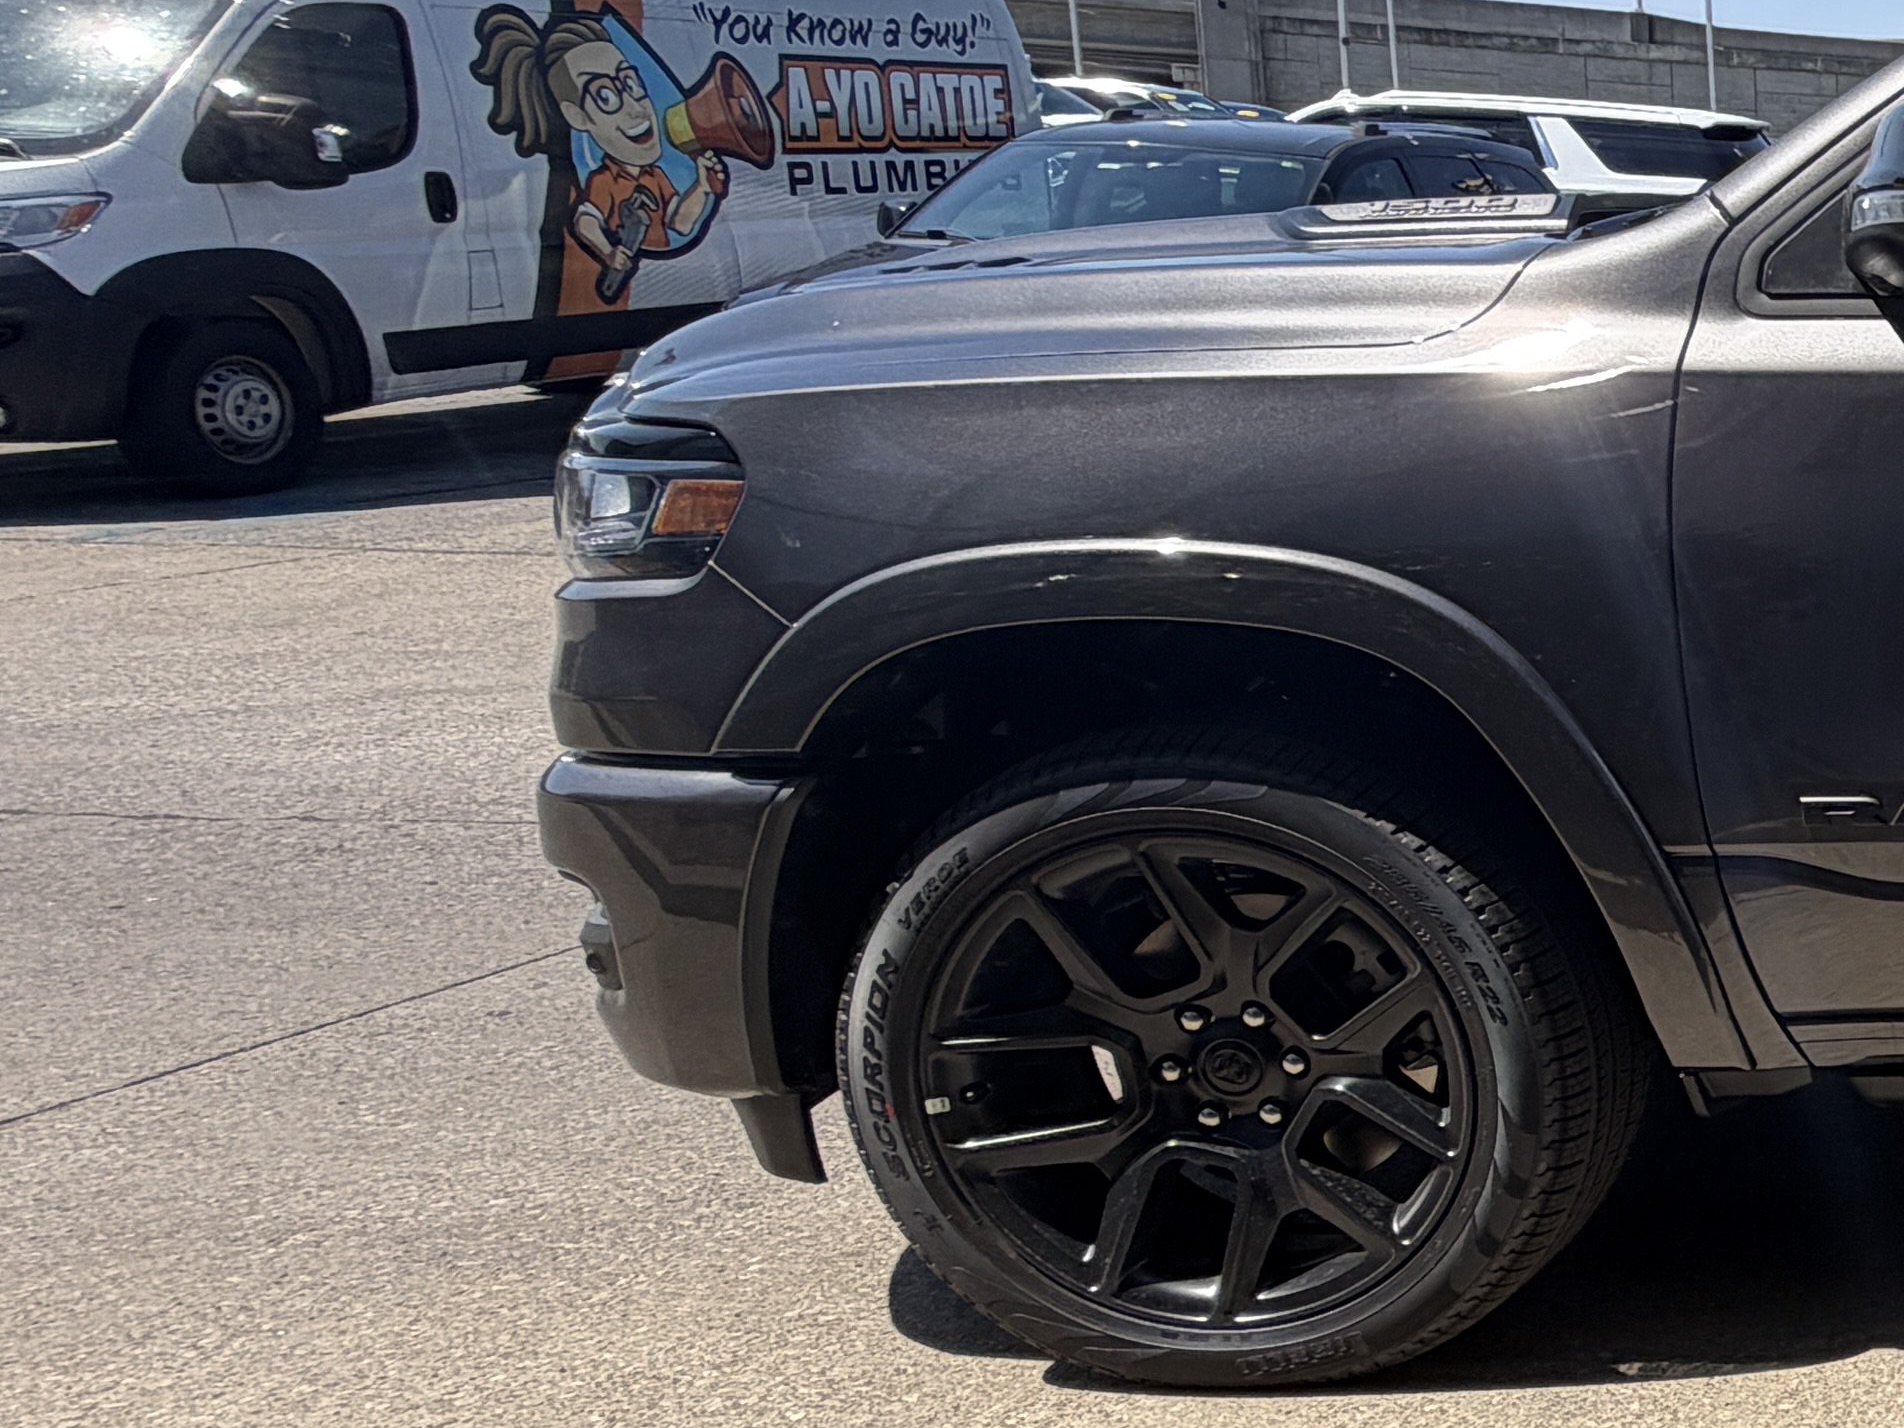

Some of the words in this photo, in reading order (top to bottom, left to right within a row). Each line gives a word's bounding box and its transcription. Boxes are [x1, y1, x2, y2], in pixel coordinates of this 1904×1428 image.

[784, 8, 873, 47] Know
[883, 18, 901, 47] a
[786, 66, 884, 138] A-YO
[890, 71, 1008, 139] CATOE
[862, 948, 910, 1183] SCORPION
